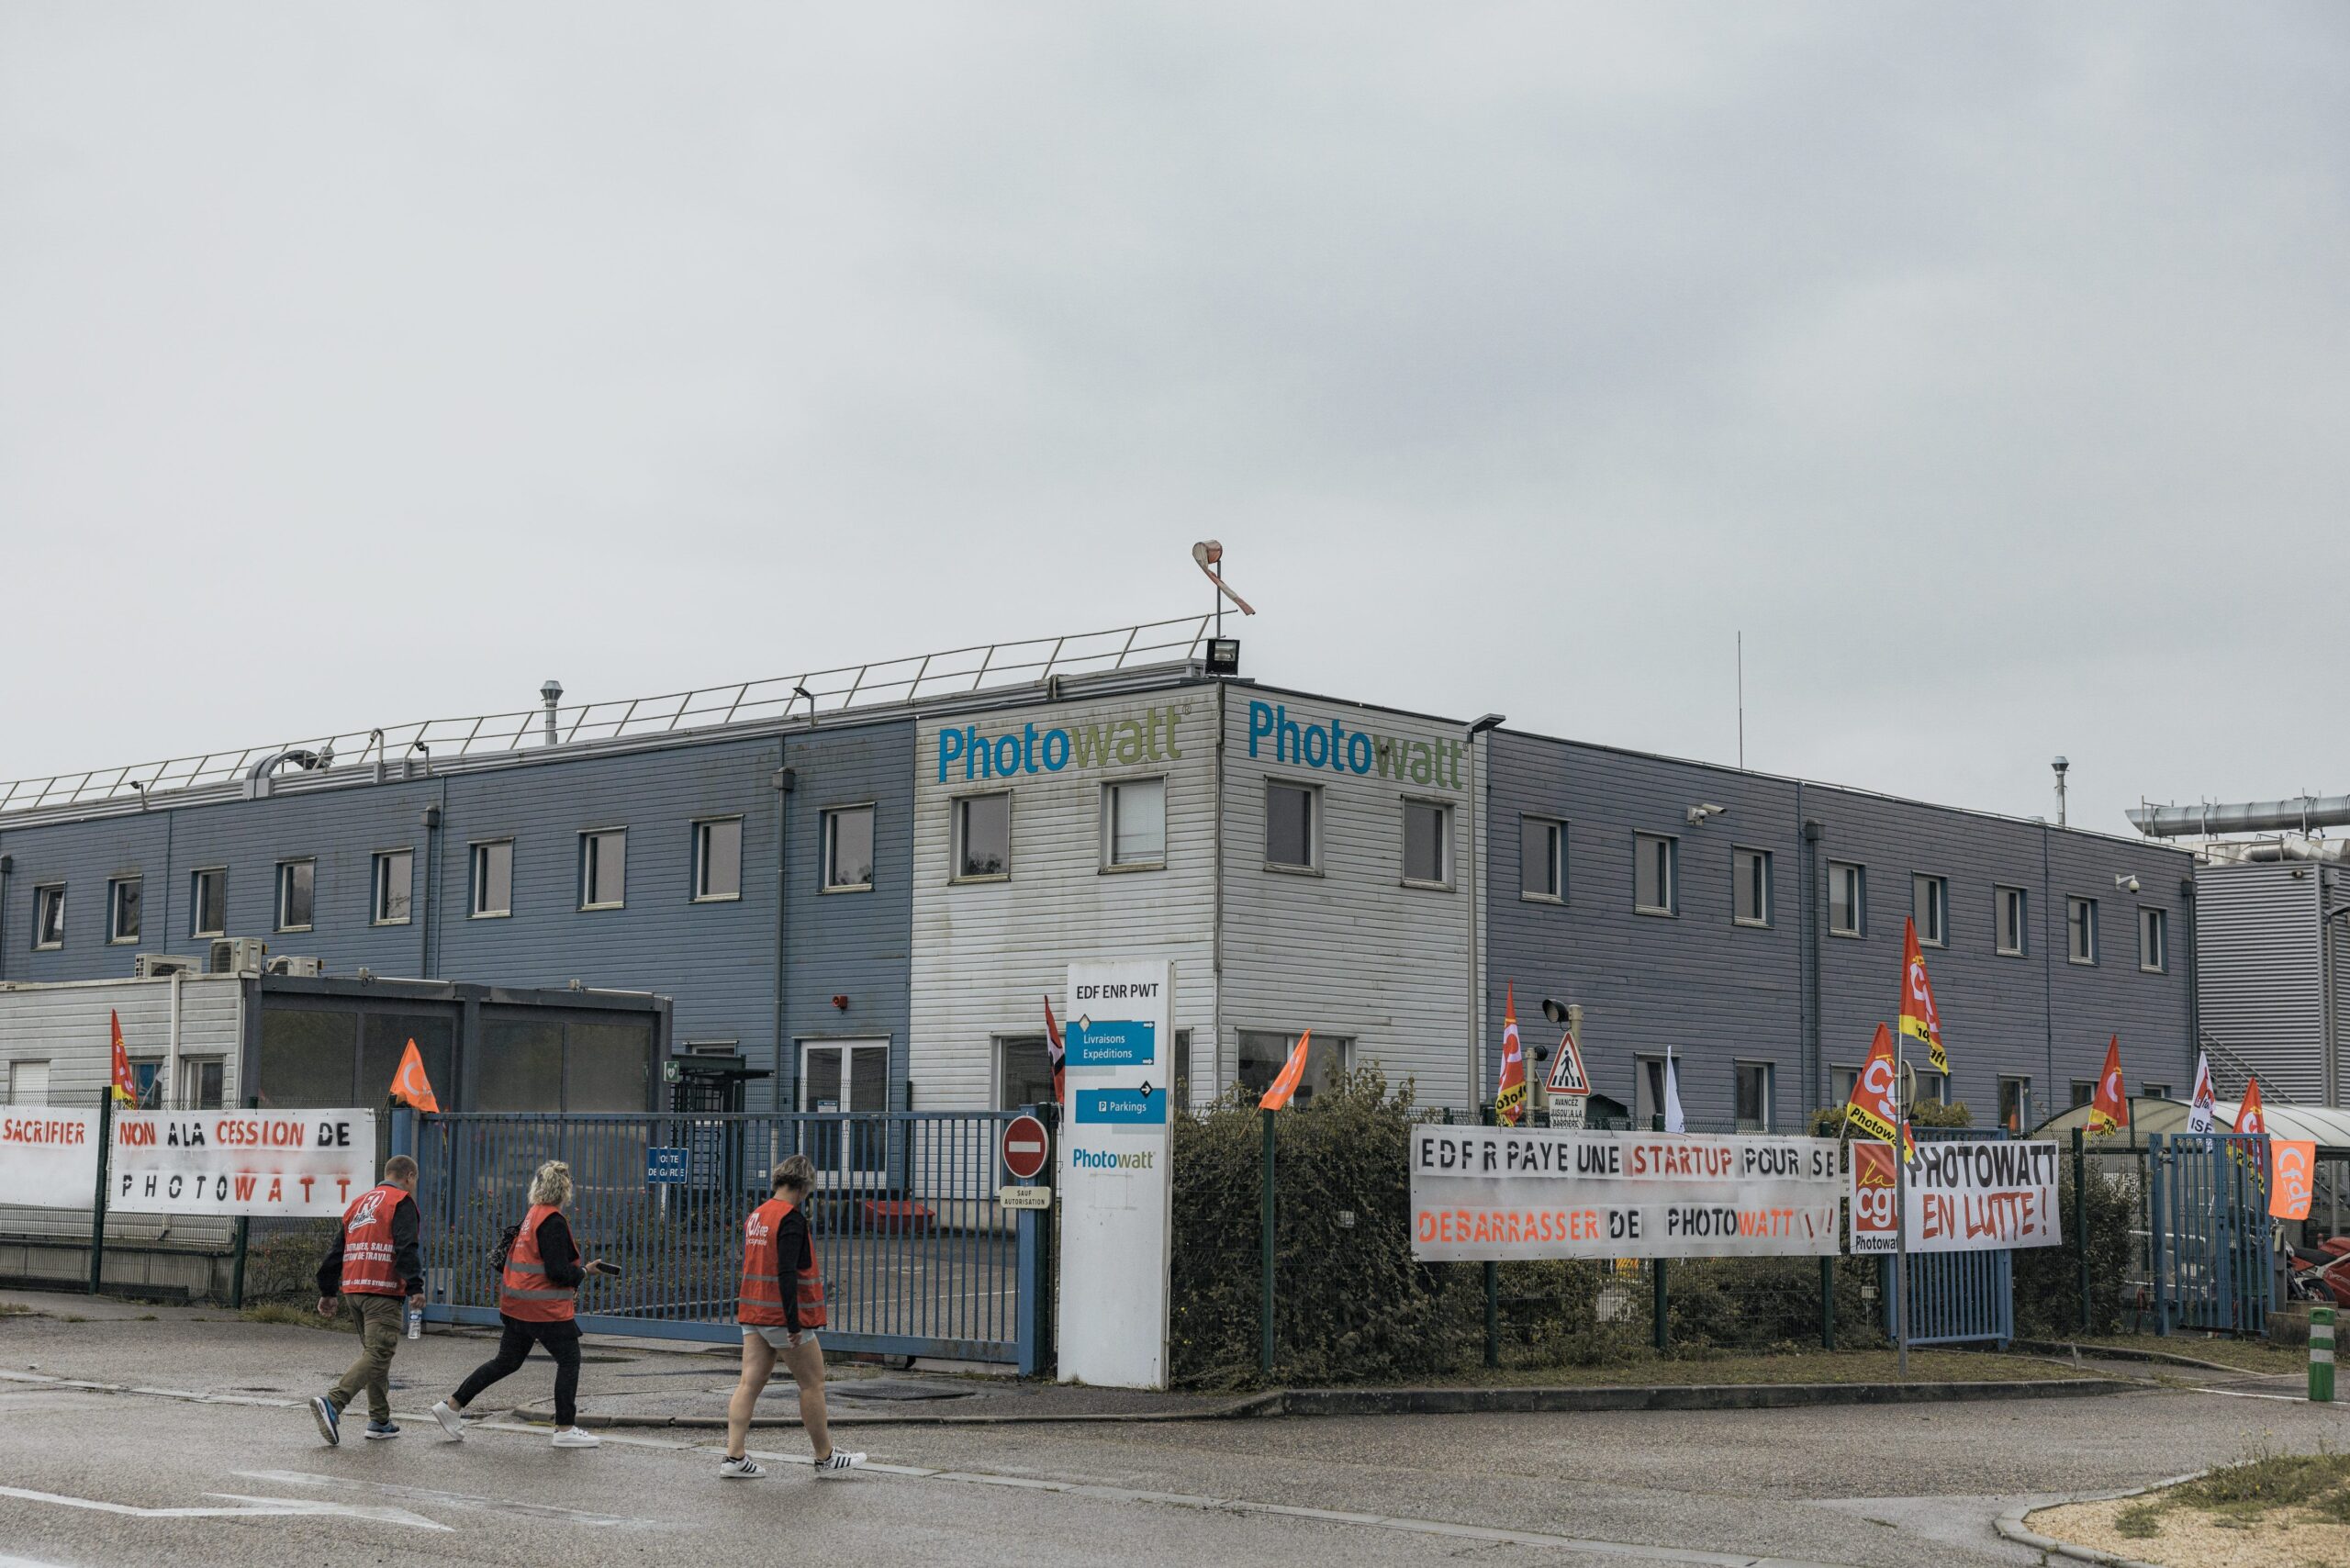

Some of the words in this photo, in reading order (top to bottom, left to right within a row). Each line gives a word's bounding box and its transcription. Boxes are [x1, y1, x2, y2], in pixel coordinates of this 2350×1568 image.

[1077, 985, 1100, 999] EDF
[1102, 984, 1127, 998] ENR
[1130, 983, 1158, 997] PWT
[1083, 1035, 1125, 1044] Livraisons
[1083, 1048, 1133, 1059] Expéditions
[1110, 1102, 1147, 1114] Parkings
[3, 1118, 84, 1145] SACRIFIER
[119, 1122, 156, 1146] NON
[216, 1120, 304, 1147] CESSION
[318, 1122, 350, 1147] DE
[1851, 1108, 1907, 1150] Photowa
[1422, 1138, 1473, 1170] EDF
[1507, 1141, 1568, 1171] PAYE
[1577, 1144, 1619, 1173] UNE
[1634, 1146, 1732, 1176] STARTUP
[1746, 1148, 1799, 1175] POUR
[1813, 1149, 1834, 1177] SE
[1906, 1145, 2056, 1188] PHOTOWATT
[1418, 1210, 1599, 1242] DEBARRASSER
[1609, 1210, 1639, 1238] DE
[1668, 1208, 1793, 1237] PHOTOWATT
[1923, 1193, 1954, 1239] EN
